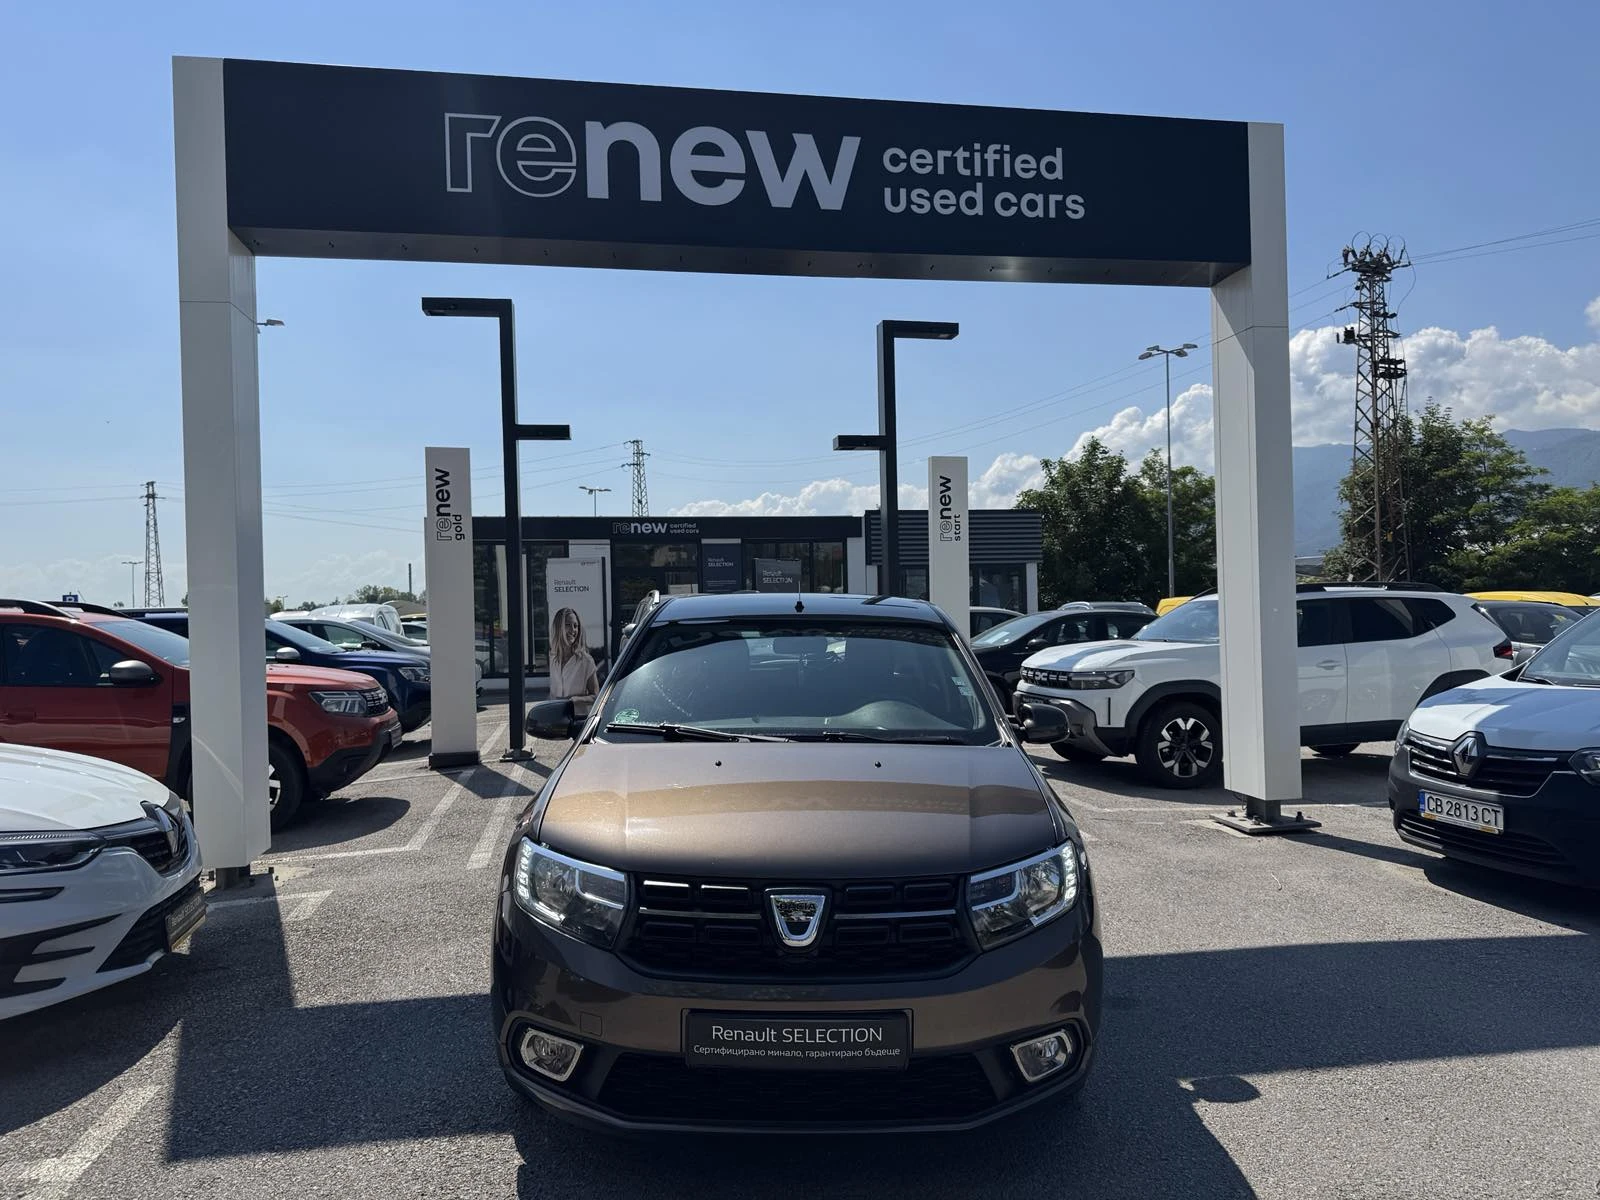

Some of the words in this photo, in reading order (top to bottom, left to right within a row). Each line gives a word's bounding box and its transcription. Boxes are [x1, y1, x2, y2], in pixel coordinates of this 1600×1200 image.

[444, 112, 862, 211] renew
[882, 143, 1064, 181] certified
[883, 184, 984, 217] used
[993, 190, 1086, 220] cars
[435, 468, 452, 541] renew
[940, 476, 952, 541] renew
[452, 514, 465, 541] gold
[612, 522, 667, 534] renew
[1427, 796, 1443, 814] CB
[1446, 801, 1478, 821] 2813
[1482, 808, 1500, 827] CT
[693, 1044, 766, 1056] Сертифицирано
[767, 1049, 804, 1058] минало,
[805, 1049, 863, 1058] гарантирано
[864, 1047, 901, 1057] бъдеще
[712, 1026, 777, 1043] Renault
[782, 1027, 883, 1043] SELECTION
